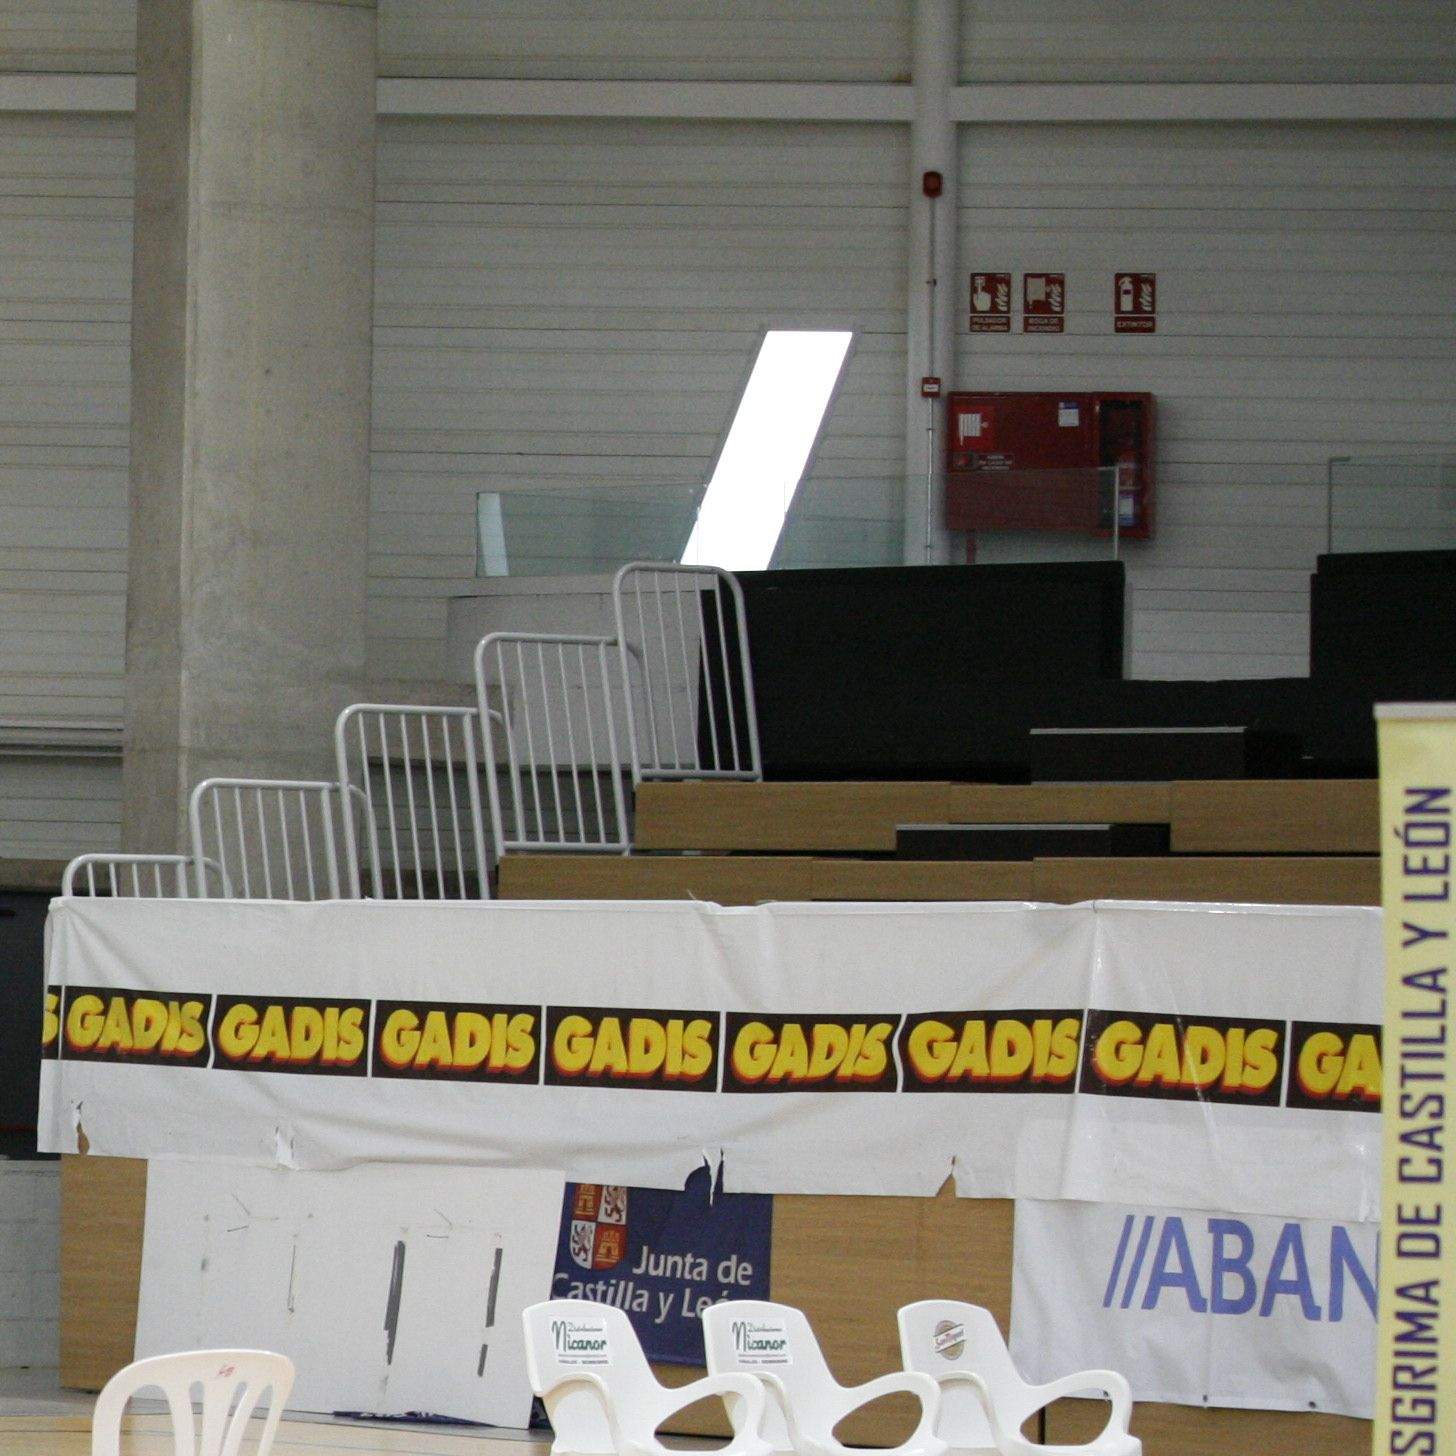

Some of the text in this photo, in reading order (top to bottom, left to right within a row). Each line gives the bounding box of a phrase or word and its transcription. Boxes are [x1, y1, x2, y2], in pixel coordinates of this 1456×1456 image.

[1394, 788, 1451, 903] LEÓN
[1402, 922, 1448, 948] Y
[67, 994, 205, 1056] GADIS
[218, 1003, 364, 1065] GADIS
[381, 1009, 536, 1074] GADIS
[553, 1015, 713, 1080] GADIS
[732, 1021, 893, 1083] GADIS
[908, 1018, 1079, 1083] GADIS
[1092, 1020, 1278, 1094] GADIS
[1398, 966, 1448, 1185] CASTILLA
[1397, 1205, 1442, 1260] DE
[632, 1245, 753, 1286] Junta de
[551, 1273, 648, 1313] Castilla
[654, 1290, 674, 1324] y
[551, 1320, 607, 1352] Nicanor
[731, 1321, 787, 1352] Nicanor
